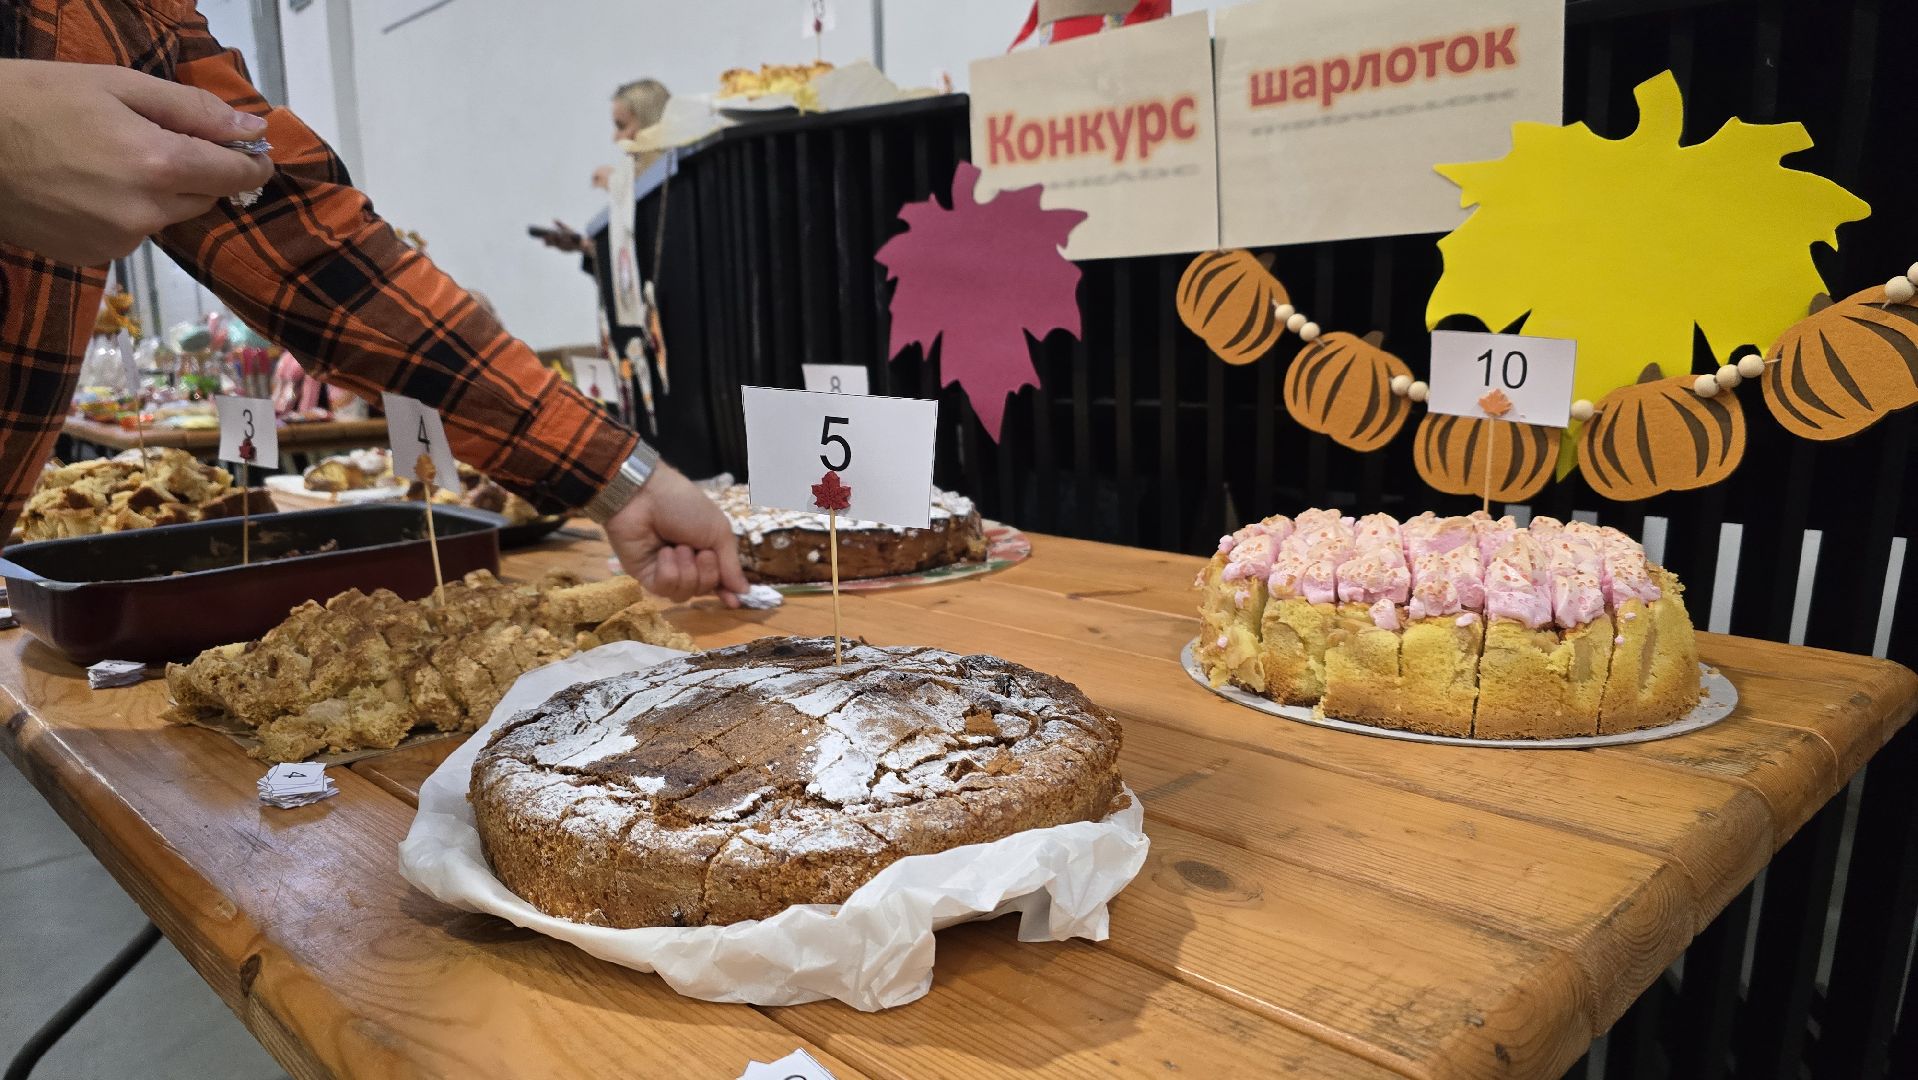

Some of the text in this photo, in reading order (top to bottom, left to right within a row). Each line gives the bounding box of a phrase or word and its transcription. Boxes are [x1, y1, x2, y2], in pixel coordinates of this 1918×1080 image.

[1249, 27, 1517, 108] шарлоток
[986, 96, 1197, 165] Конкурс
[1477, 348, 1528, 390] 10
[242, 408, 255, 440] 3
[417, 415, 430, 454] 4
[819, 415, 852, 472] 5
